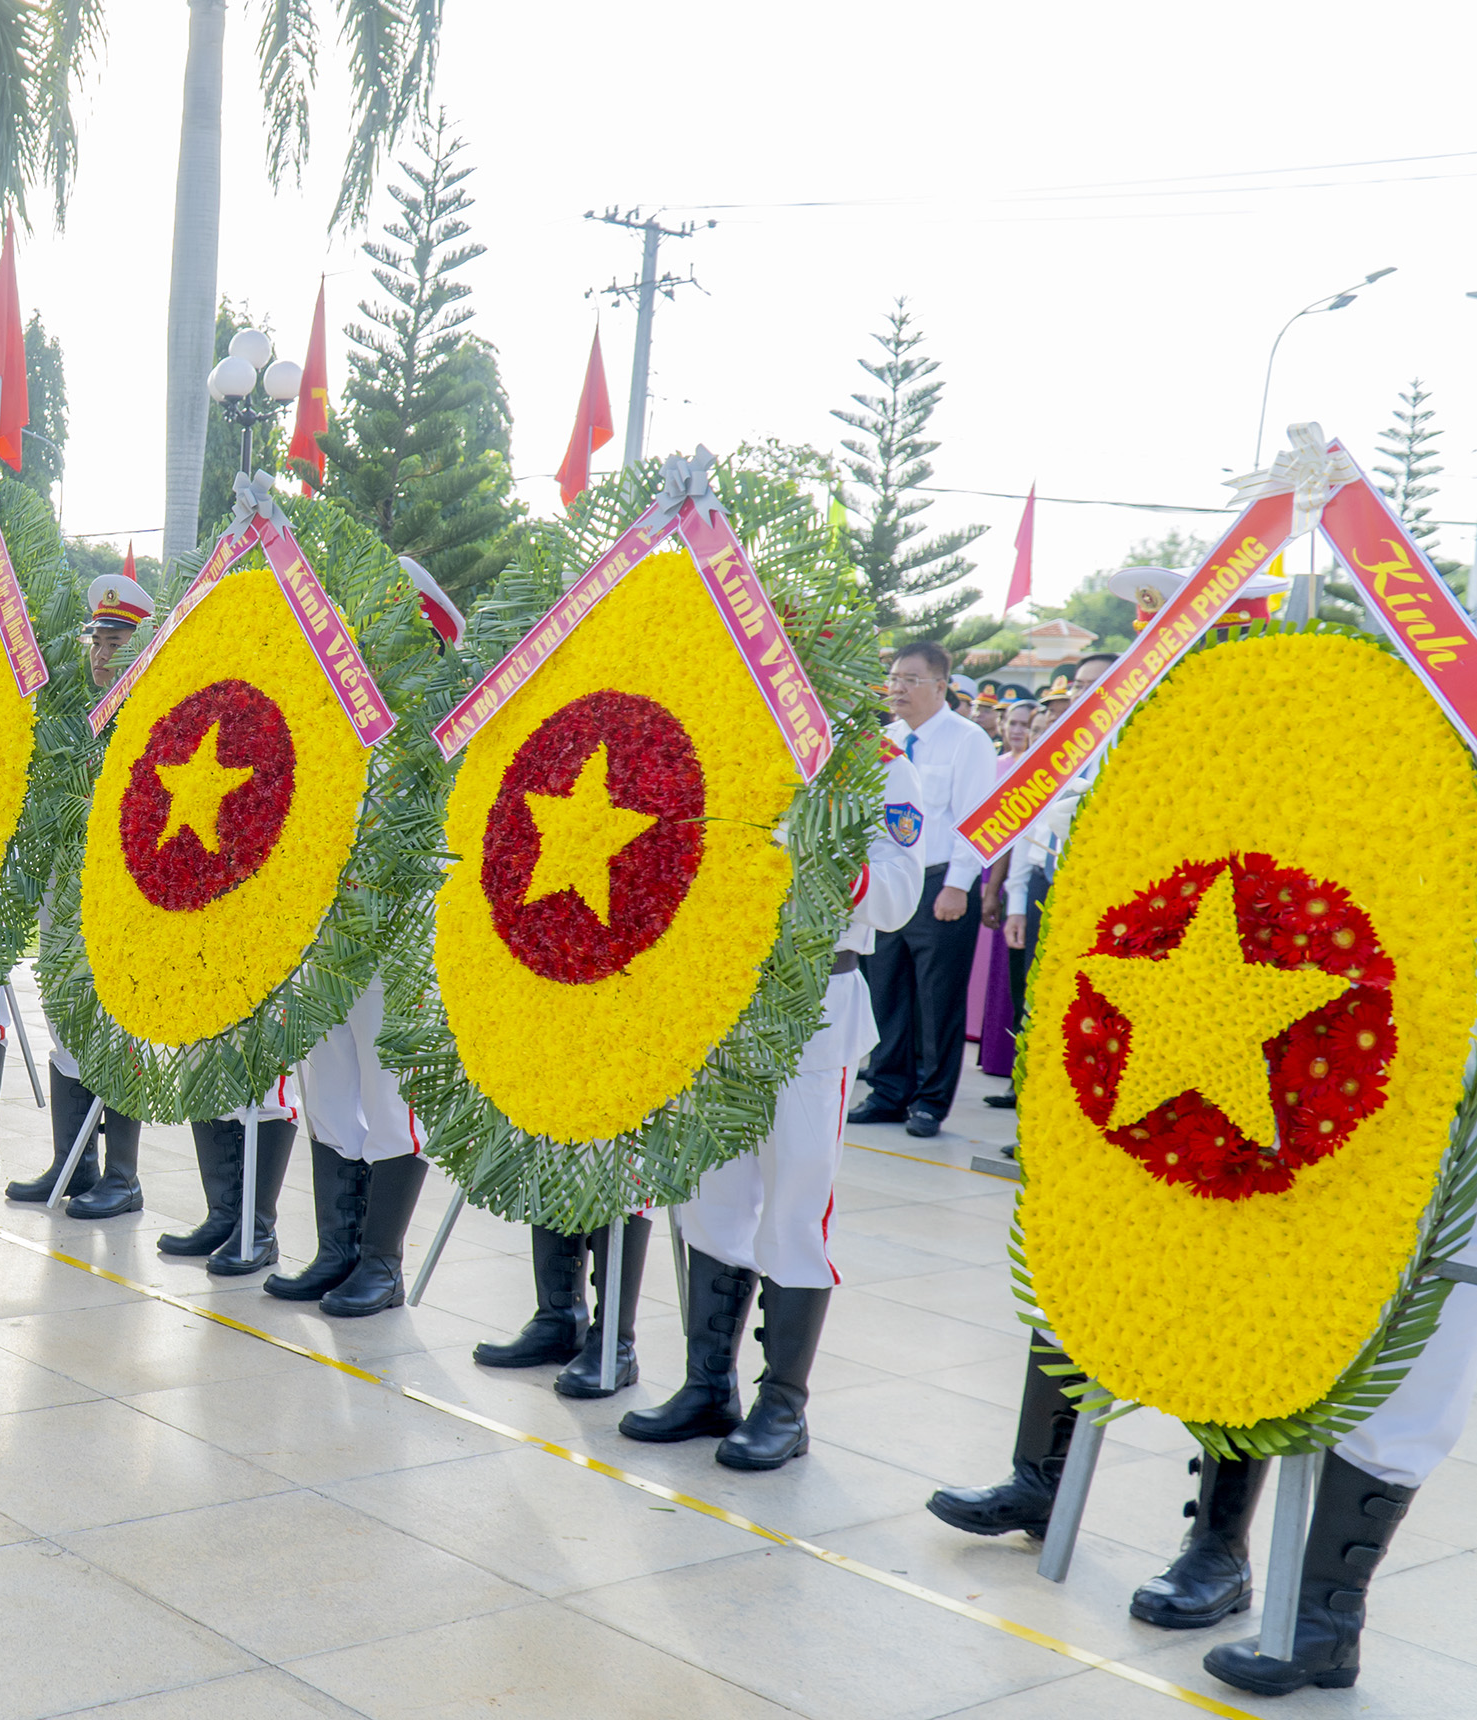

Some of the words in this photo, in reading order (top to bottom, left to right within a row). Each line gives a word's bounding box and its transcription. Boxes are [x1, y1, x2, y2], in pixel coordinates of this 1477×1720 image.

[0, 596, 20, 621] Anh
[6, 615, 28, 655] Hùng
[16, 645, 37, 676] Liệt
[284, 556, 329, 636] Kính
[326, 631, 381, 729] Viếng
[443, 718, 476, 752] CÁN
[472, 685, 498, 721] BỘ
[496, 652, 532, 696] HƯU
[530, 615, 564, 658] TRÍ
[561, 577, 604, 626] TỈNH
[602, 552, 631, 586] BR
[708, 542, 767, 640] Kính
[759, 634, 823, 759] Viếng
[1352, 538, 1468, 671] Kính
[968, 767, 1059, 853] TRƯỜNG
[1053, 727, 1096, 776] CAO
[1090, 674, 1151, 733] ĐẲNG
[1144, 613, 1196, 676] BIÊN
[1195, 535, 1269, 620] PHÒNG
